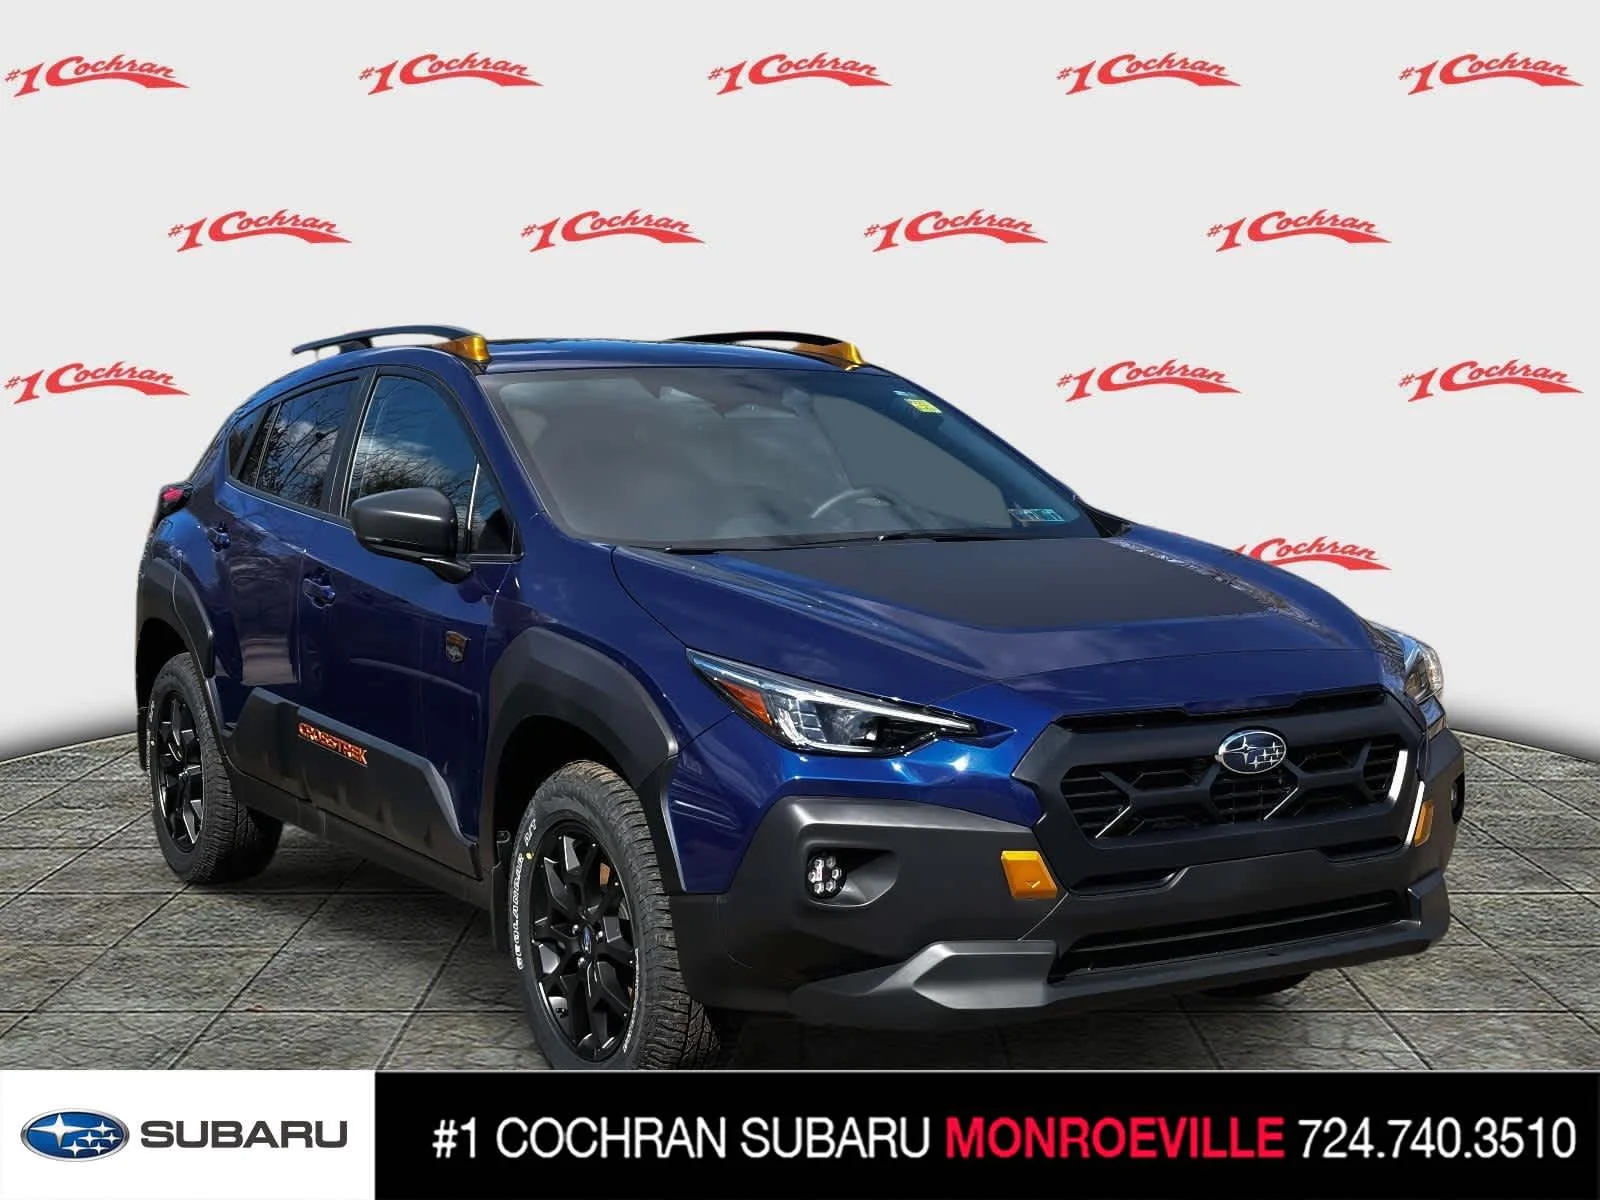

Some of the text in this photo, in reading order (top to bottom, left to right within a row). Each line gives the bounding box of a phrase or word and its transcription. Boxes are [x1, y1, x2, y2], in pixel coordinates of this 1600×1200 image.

[4, 54, 188, 97] #1 Cochran
[359, 52, 542, 95] #1 Cochran
[707, 52, 891, 95] #1 Cochran
[1056, 52, 1240, 95] #1 Cochran
[1399, 52, 1583, 95] #1 Cochran
[167, 209, 351, 253] #1 Cochran
[520, 209, 703, 252] #1 Cochran
[864, 209, 1047, 252] #1 Cochran
[1207, 209, 1390, 252] #1 Cochran
[3, 361, 188, 404] #1 Cochran
[1056, 358, 1240, 403] #1 Cochran
[1398, 358, 1581, 402] #1 Cochran
[1250, 536, 1389, 571] Cochran
